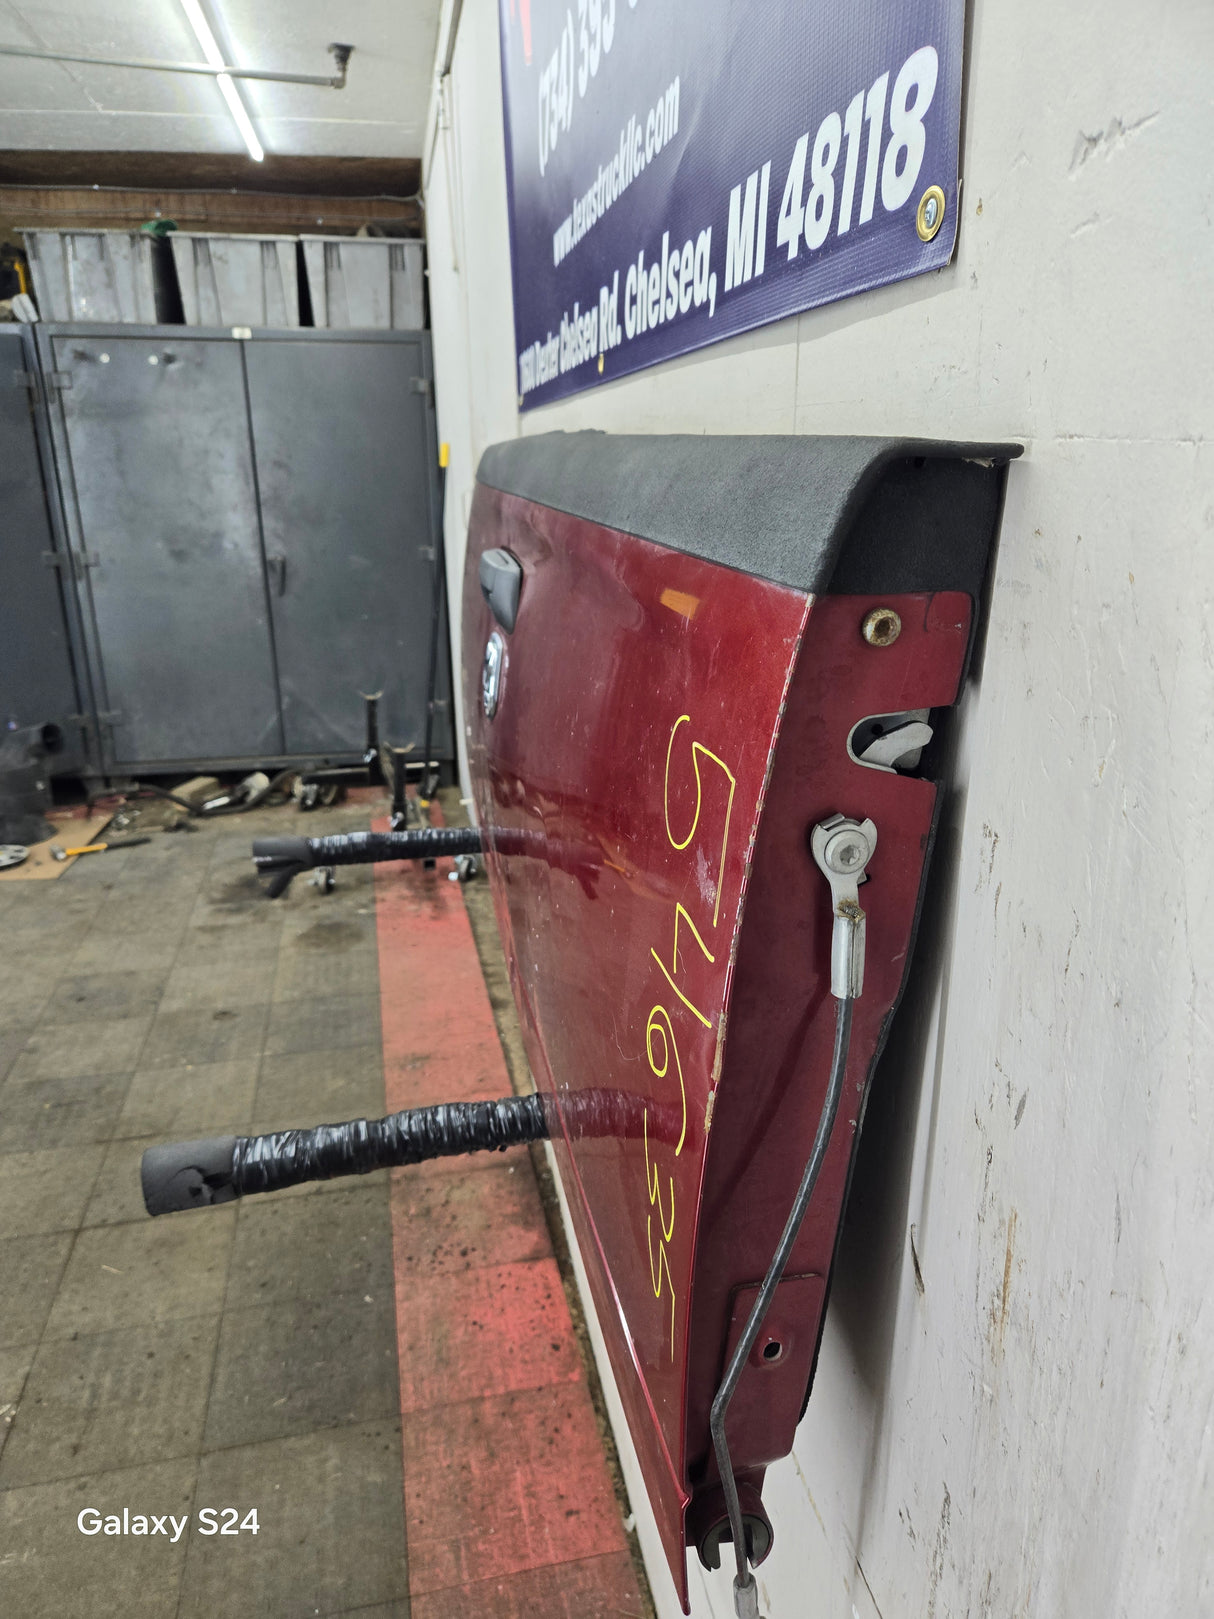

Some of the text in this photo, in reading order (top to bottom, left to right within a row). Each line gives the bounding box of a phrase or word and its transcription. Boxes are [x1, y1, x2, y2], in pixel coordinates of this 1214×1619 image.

[560, 301, 598, 374] Chelsea
[599, 269, 622, 353] Rd.
[624, 225, 717, 340] Chelsea,
[724, 159, 771, 292] MI
[776, 45, 939, 262] 48118
